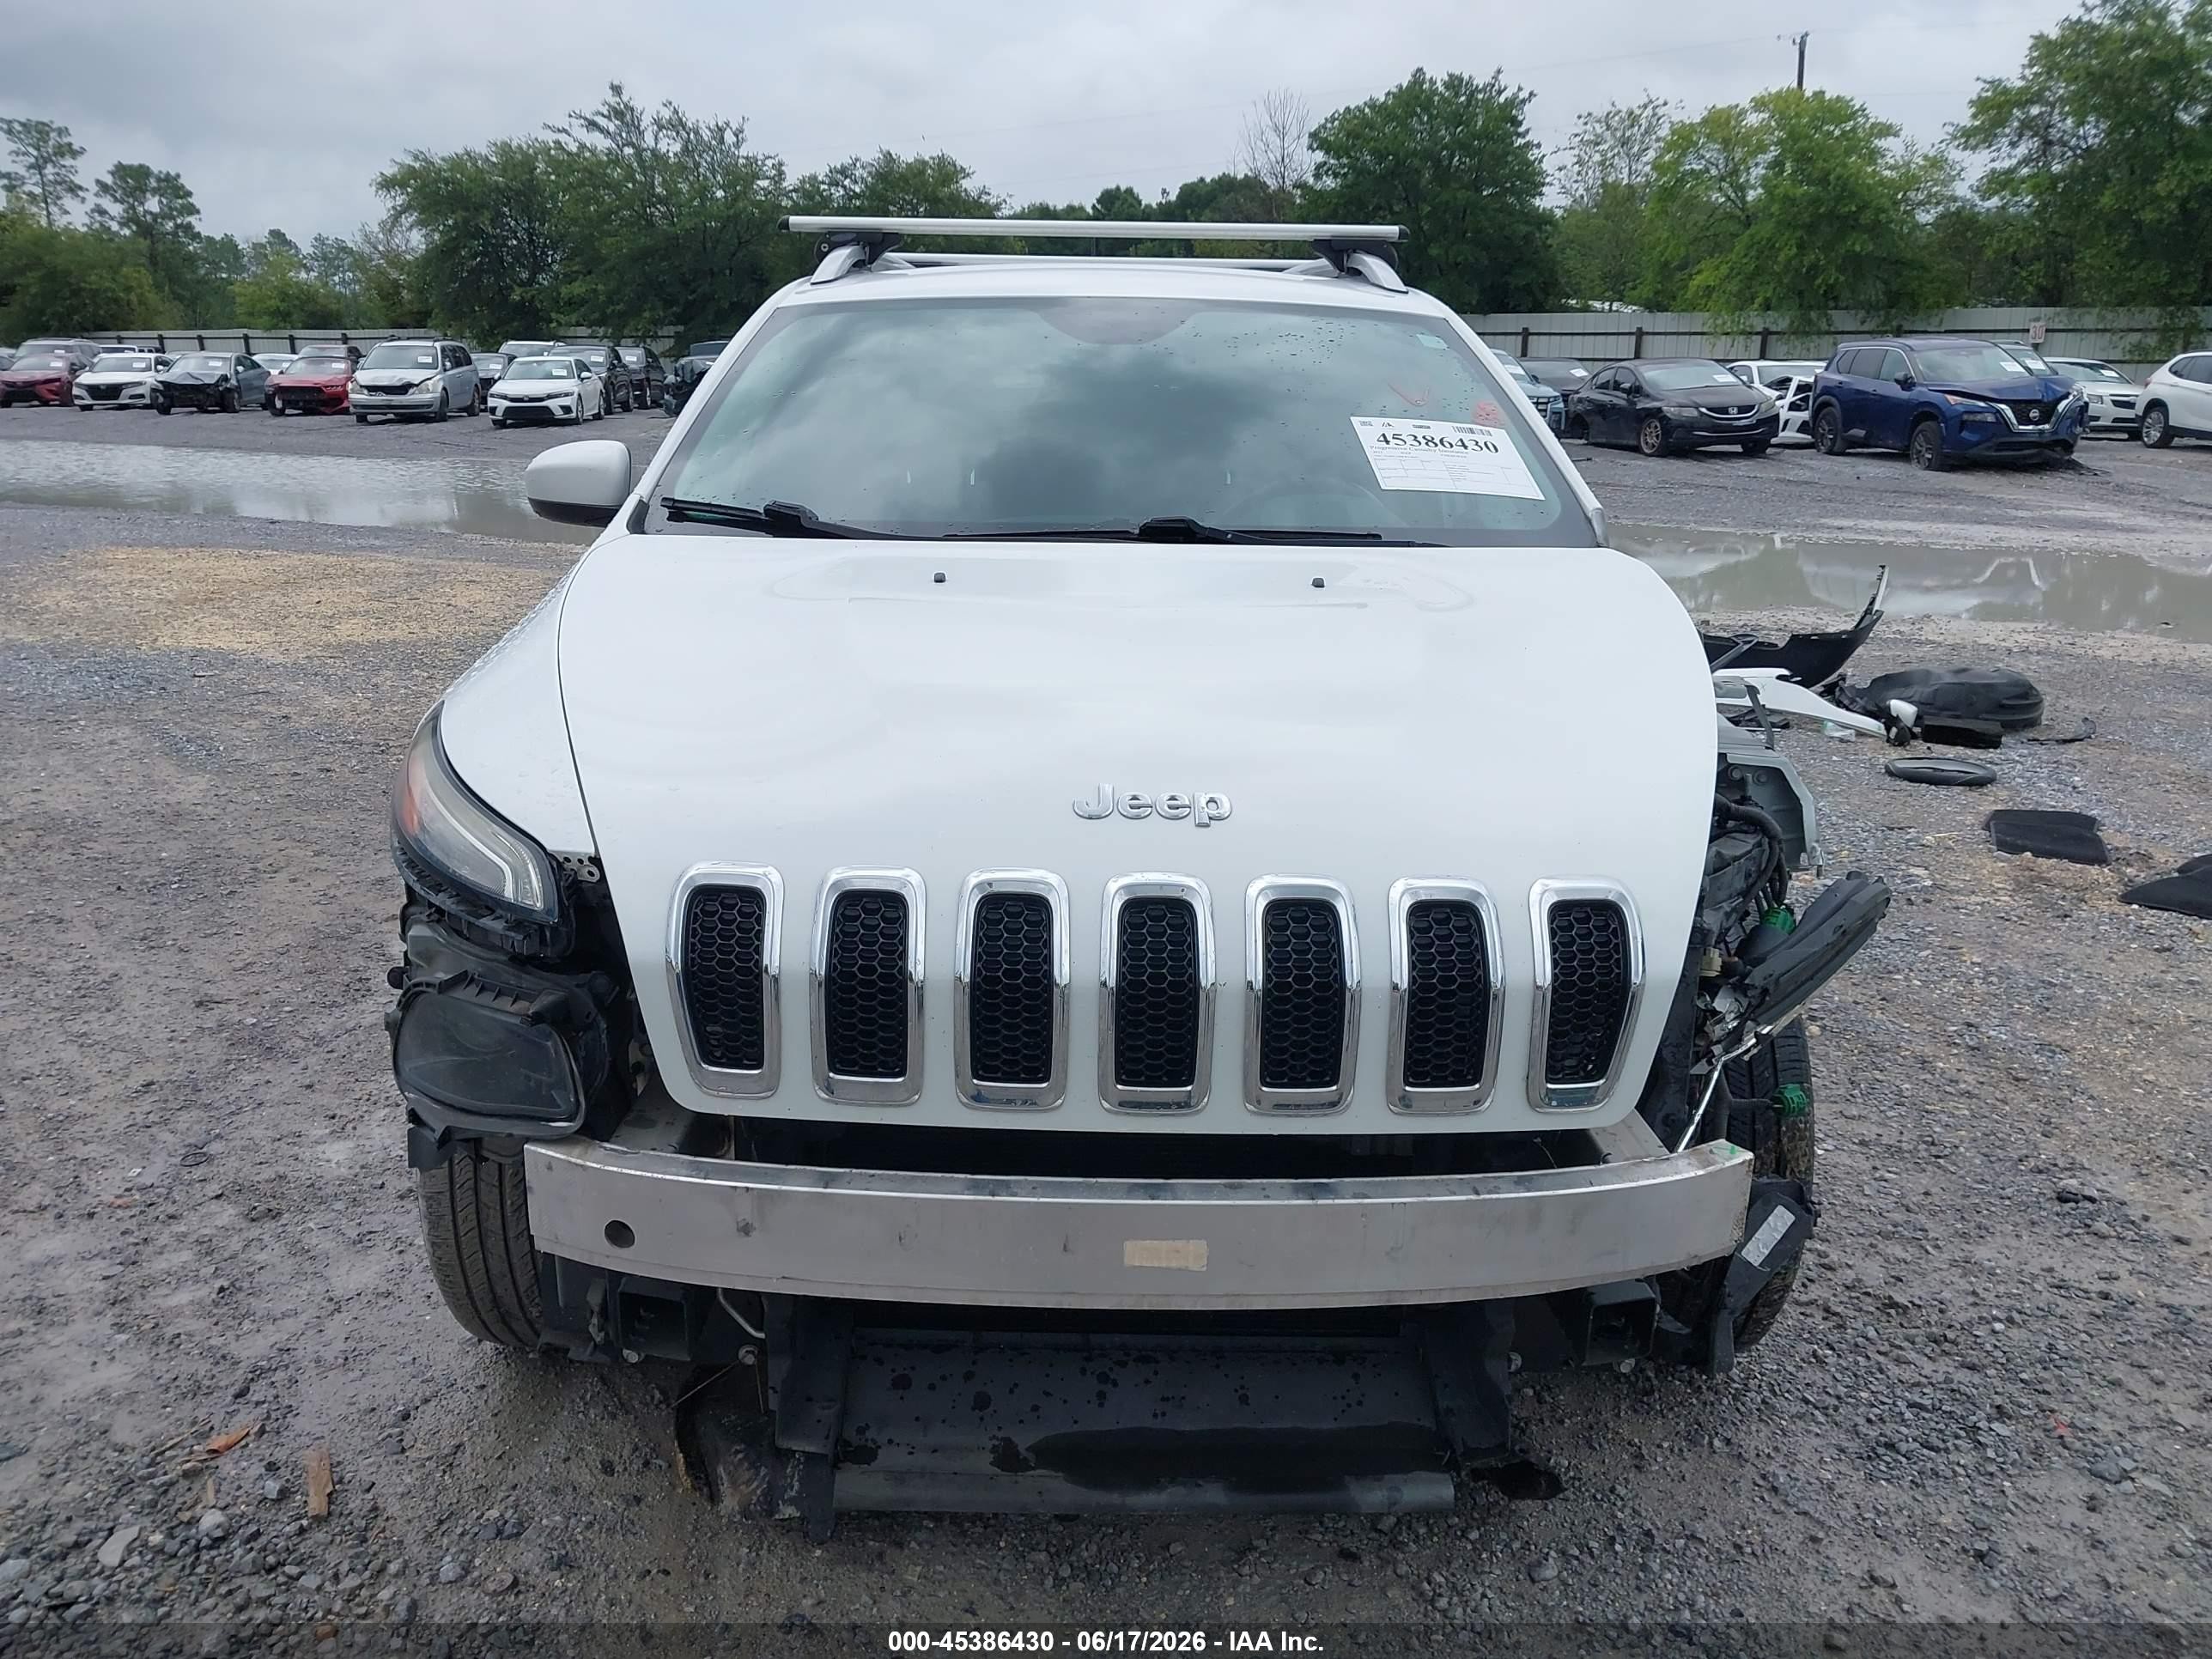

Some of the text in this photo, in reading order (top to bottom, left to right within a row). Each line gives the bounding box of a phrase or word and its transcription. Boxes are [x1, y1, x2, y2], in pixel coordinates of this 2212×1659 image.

[2033, 325, 2045, 339] 30
[1376, 433, 1499, 453] 45386430
[1073, 783, 1232, 827] Jeep
